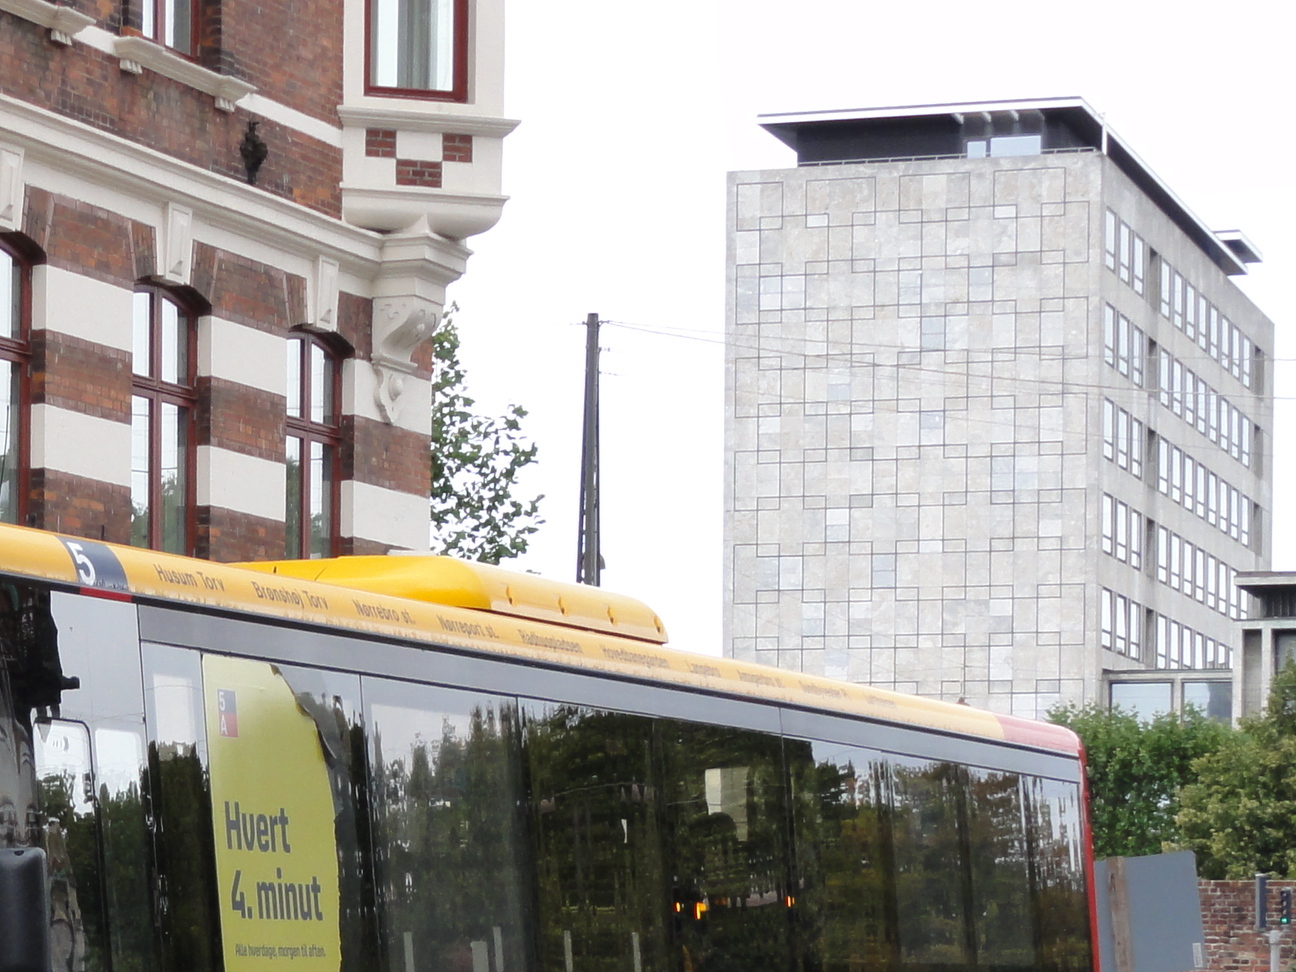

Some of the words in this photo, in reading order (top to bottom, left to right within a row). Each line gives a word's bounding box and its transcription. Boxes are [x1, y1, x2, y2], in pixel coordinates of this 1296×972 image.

[66, 541, 96, 586] 5
[153, 563, 197, 587] Husum
[197, 570, 225, 592] Torv
[251, 580, 303, 609] Brønshøj
[302, 589, 329, 610] Torv
[353, 599, 400, 622] Nørrebro
[436, 614, 483, 638] Nørreport
[218, 690, 226, 712] 5
[219, 714, 229, 736] A
[224, 801, 291, 853] Hvert
[231, 869, 253, 919] 4.
[256, 867, 323, 921] minut
